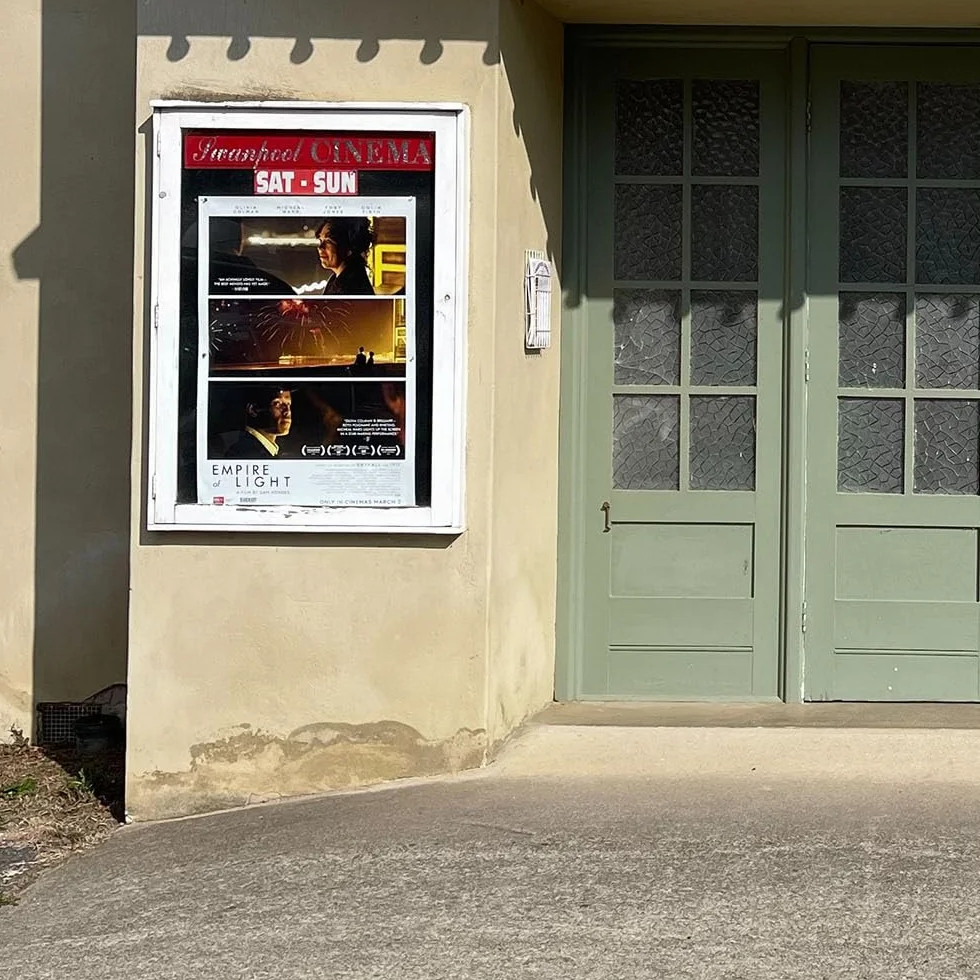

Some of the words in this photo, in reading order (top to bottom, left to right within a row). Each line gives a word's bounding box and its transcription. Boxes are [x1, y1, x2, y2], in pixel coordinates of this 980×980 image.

[193, 136, 304, 170] Swanpool
[310, 139, 432, 165] CINEMA
[256, 171, 294, 193] SAT
[313, 171, 356, 193] SUN
[212, 464, 269, 475] EMPIRE
[236, 476, 291, 488] LIGHT
